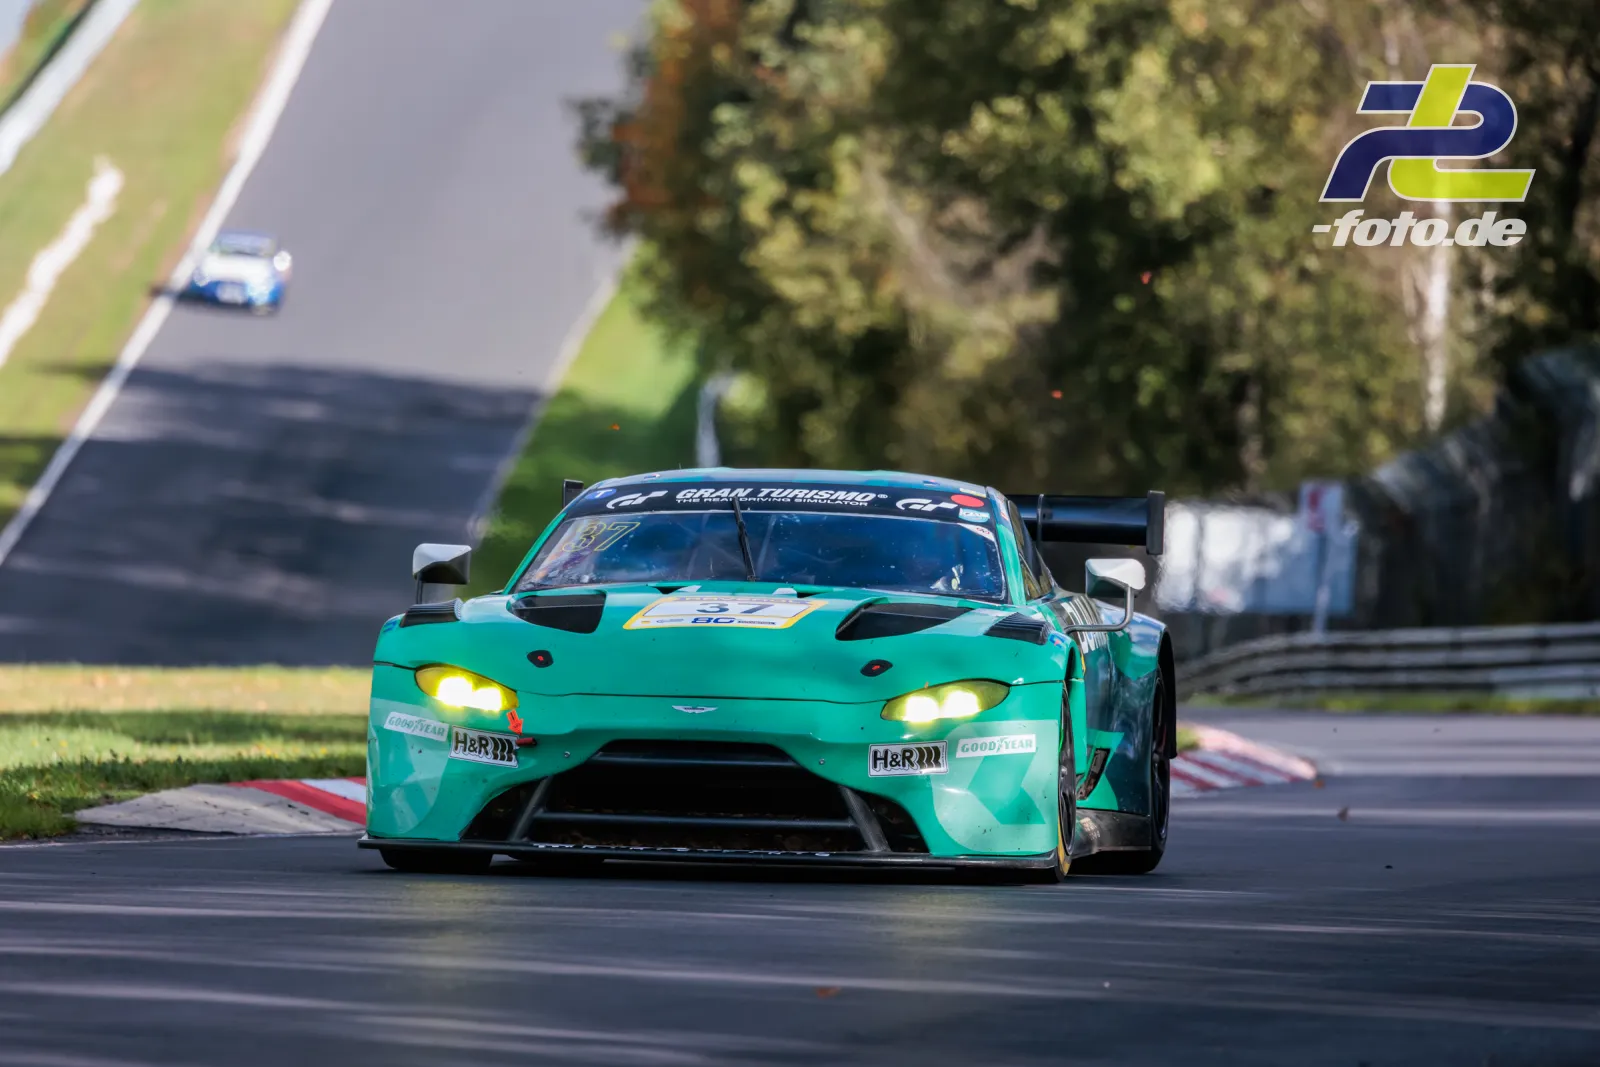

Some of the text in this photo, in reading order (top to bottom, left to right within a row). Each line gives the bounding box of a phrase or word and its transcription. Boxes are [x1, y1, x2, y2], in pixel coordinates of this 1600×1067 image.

[676, 487, 753, 499] GRAN
[794, 498, 869, 506] SIMULATOR
[562, 521, 641, 553] 37
[696, 602, 774, 614] 37
[453, 730, 490, 757] H&R
[873, 748, 916, 771] H&R
